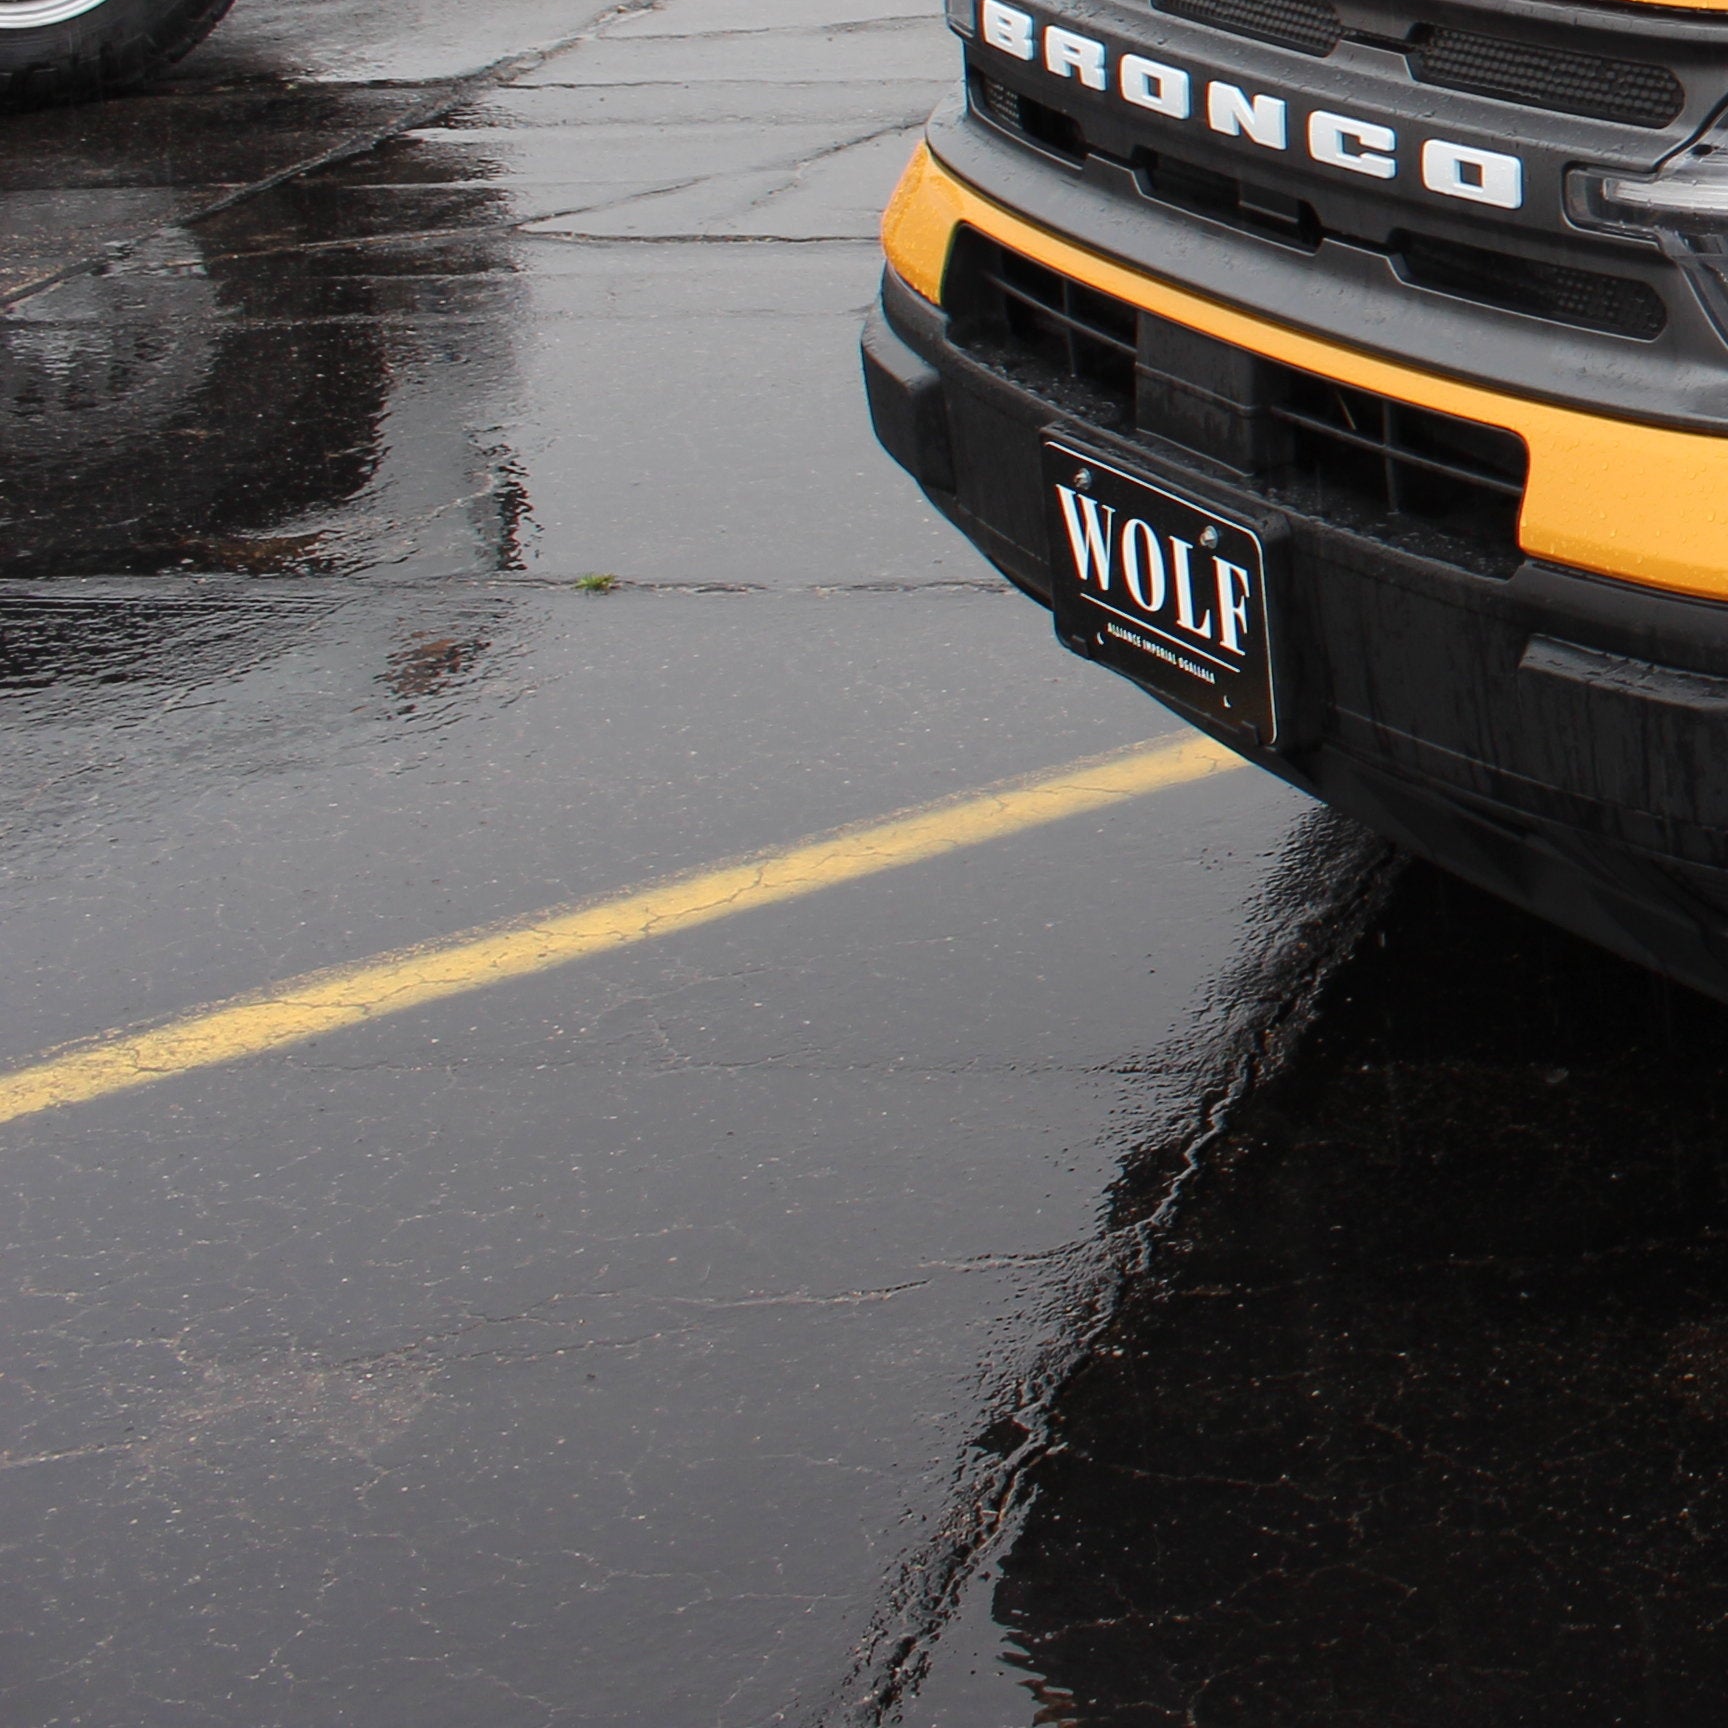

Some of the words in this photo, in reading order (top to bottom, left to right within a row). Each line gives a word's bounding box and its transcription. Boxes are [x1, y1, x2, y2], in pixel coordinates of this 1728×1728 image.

[1055, 484, 1250, 656] WOLF
[1107, 622, 1141, 648] ALLIANCE
[1142, 639, 1177, 665] IMPERIAL
[1178, 657, 1216, 685] OGALLALA
